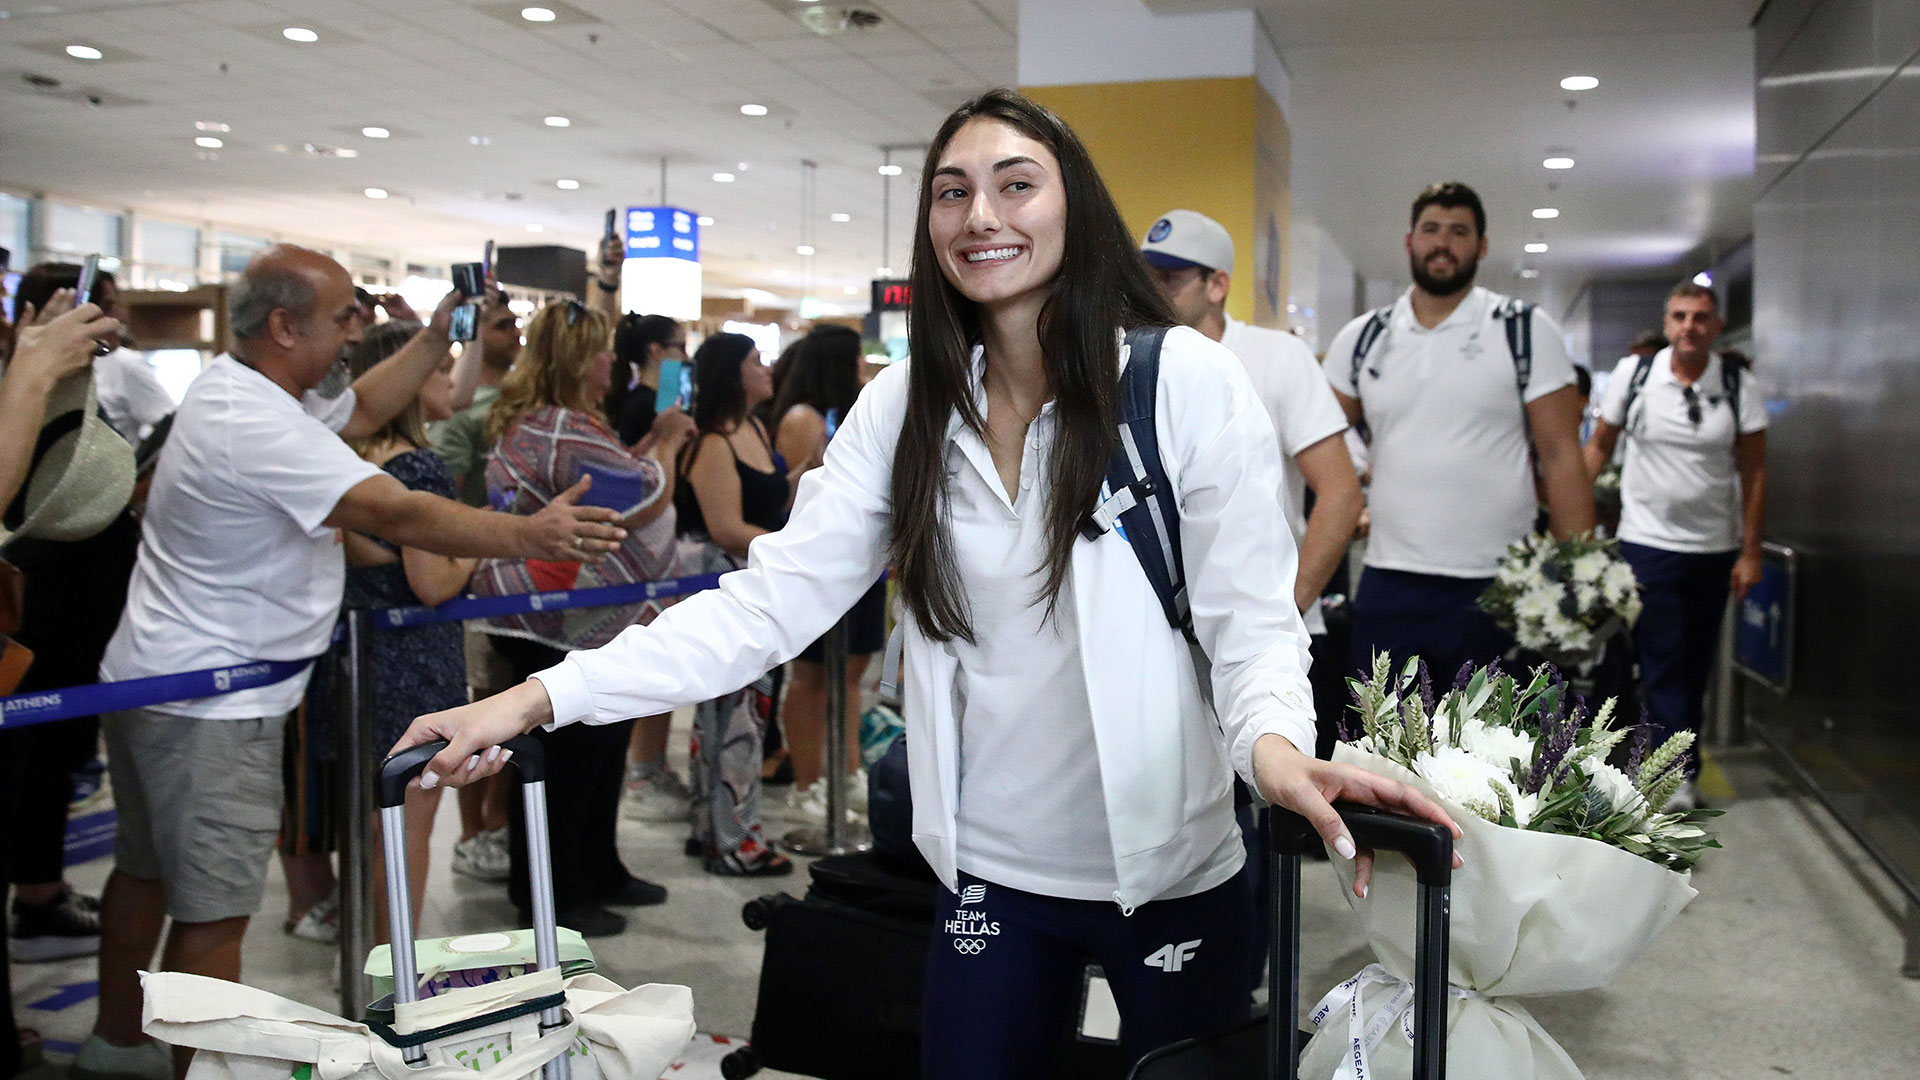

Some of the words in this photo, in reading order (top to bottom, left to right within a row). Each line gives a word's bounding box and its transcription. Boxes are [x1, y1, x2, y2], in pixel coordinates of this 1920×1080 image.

[4, 693, 62, 712] ATHENS
[955, 909, 986, 922] TEAM
[944, 919, 1001, 936] HELLAS
[1143, 938, 1203, 972] 4F
